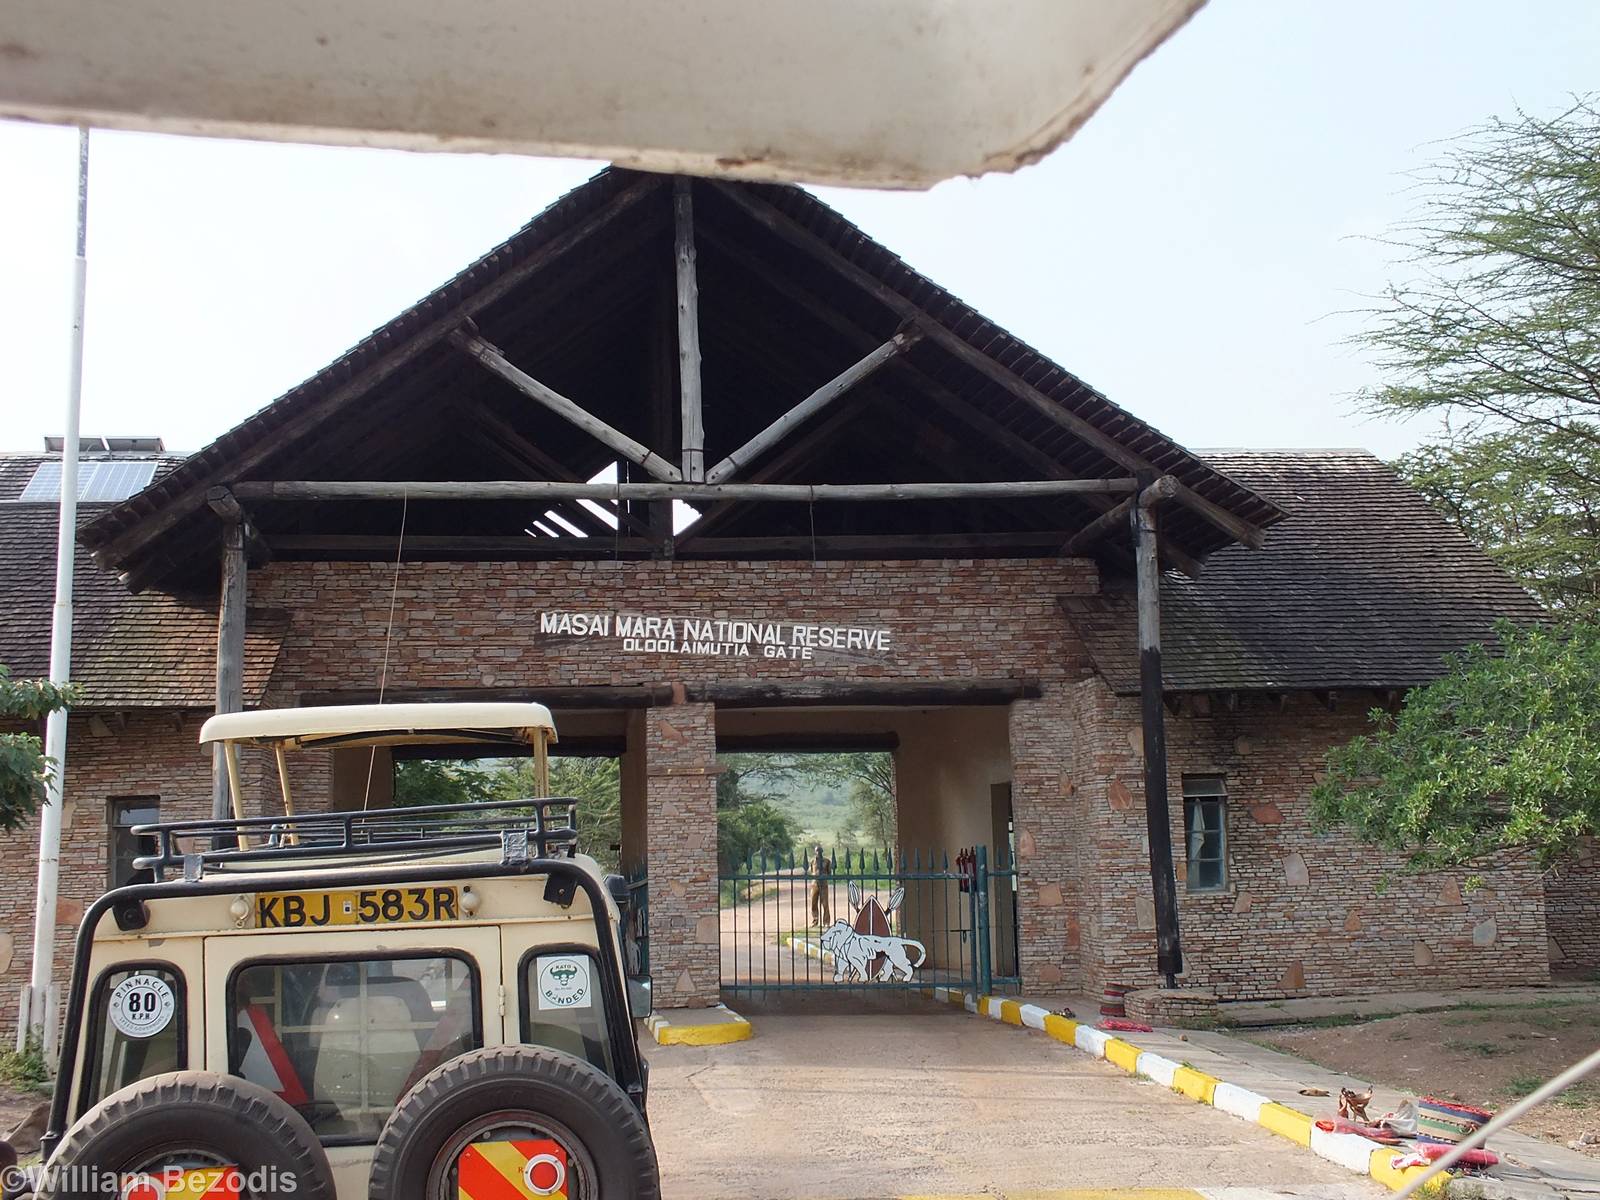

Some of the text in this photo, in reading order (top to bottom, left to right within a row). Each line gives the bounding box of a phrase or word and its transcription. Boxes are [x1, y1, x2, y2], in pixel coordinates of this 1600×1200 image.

[541, 613, 891, 651] MASAI MARA NATIONAL RESERVE
[623, 638, 812, 660] OLOOLAIMUTIA GATE
[259, 887, 456, 928] KBJ 583R
[115, 978, 169, 998] PINNACLE
[129, 992, 156, 1012] 80
